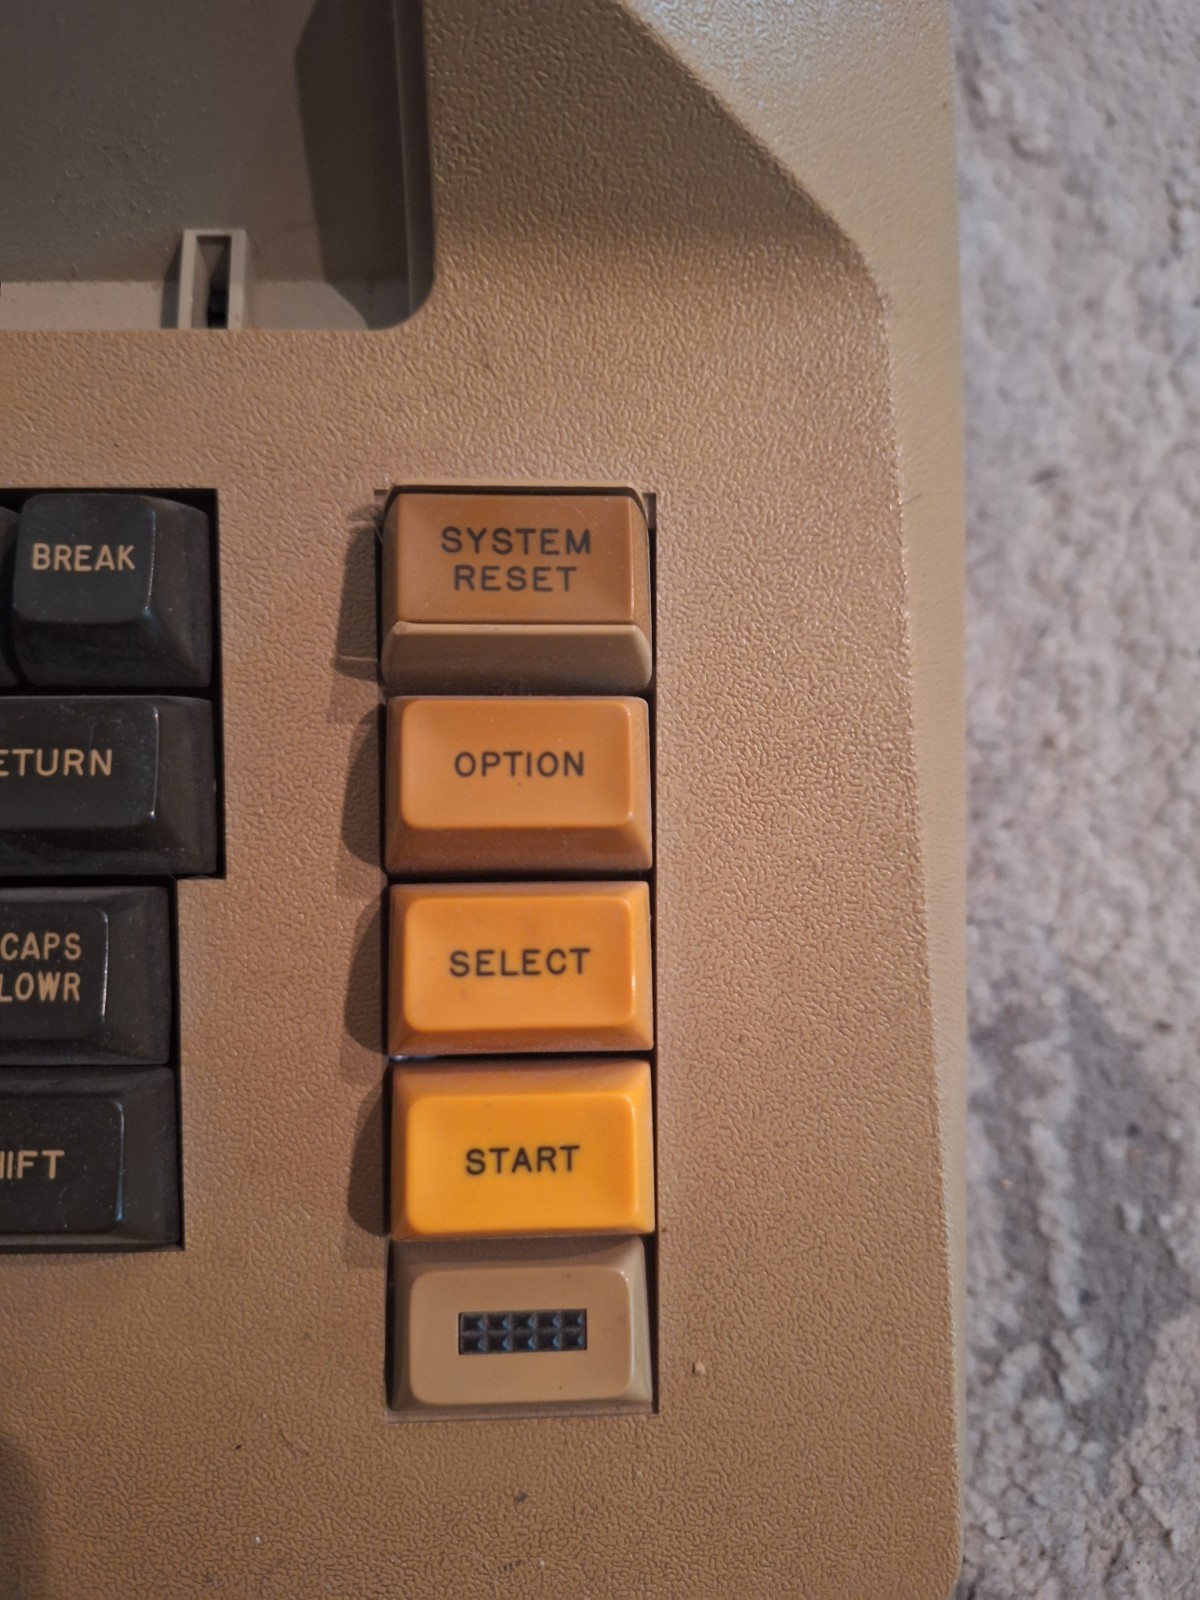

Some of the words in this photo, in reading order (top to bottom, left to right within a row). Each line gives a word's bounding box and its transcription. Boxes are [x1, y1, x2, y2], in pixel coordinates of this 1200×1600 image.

[441, 526, 592, 555] SYSTEM
[32, 543, 136, 572] BREAK
[453, 565, 577, 592] RESET
[455, 751, 585, 777] OPTION
[0, 932, 82, 960] CAPS
[449, 948, 591, 977] SELECT
[0, 971, 80, 1002] LOWR
[0, 1150, 65, 1179] IFT
[465, 1145, 580, 1175] START
